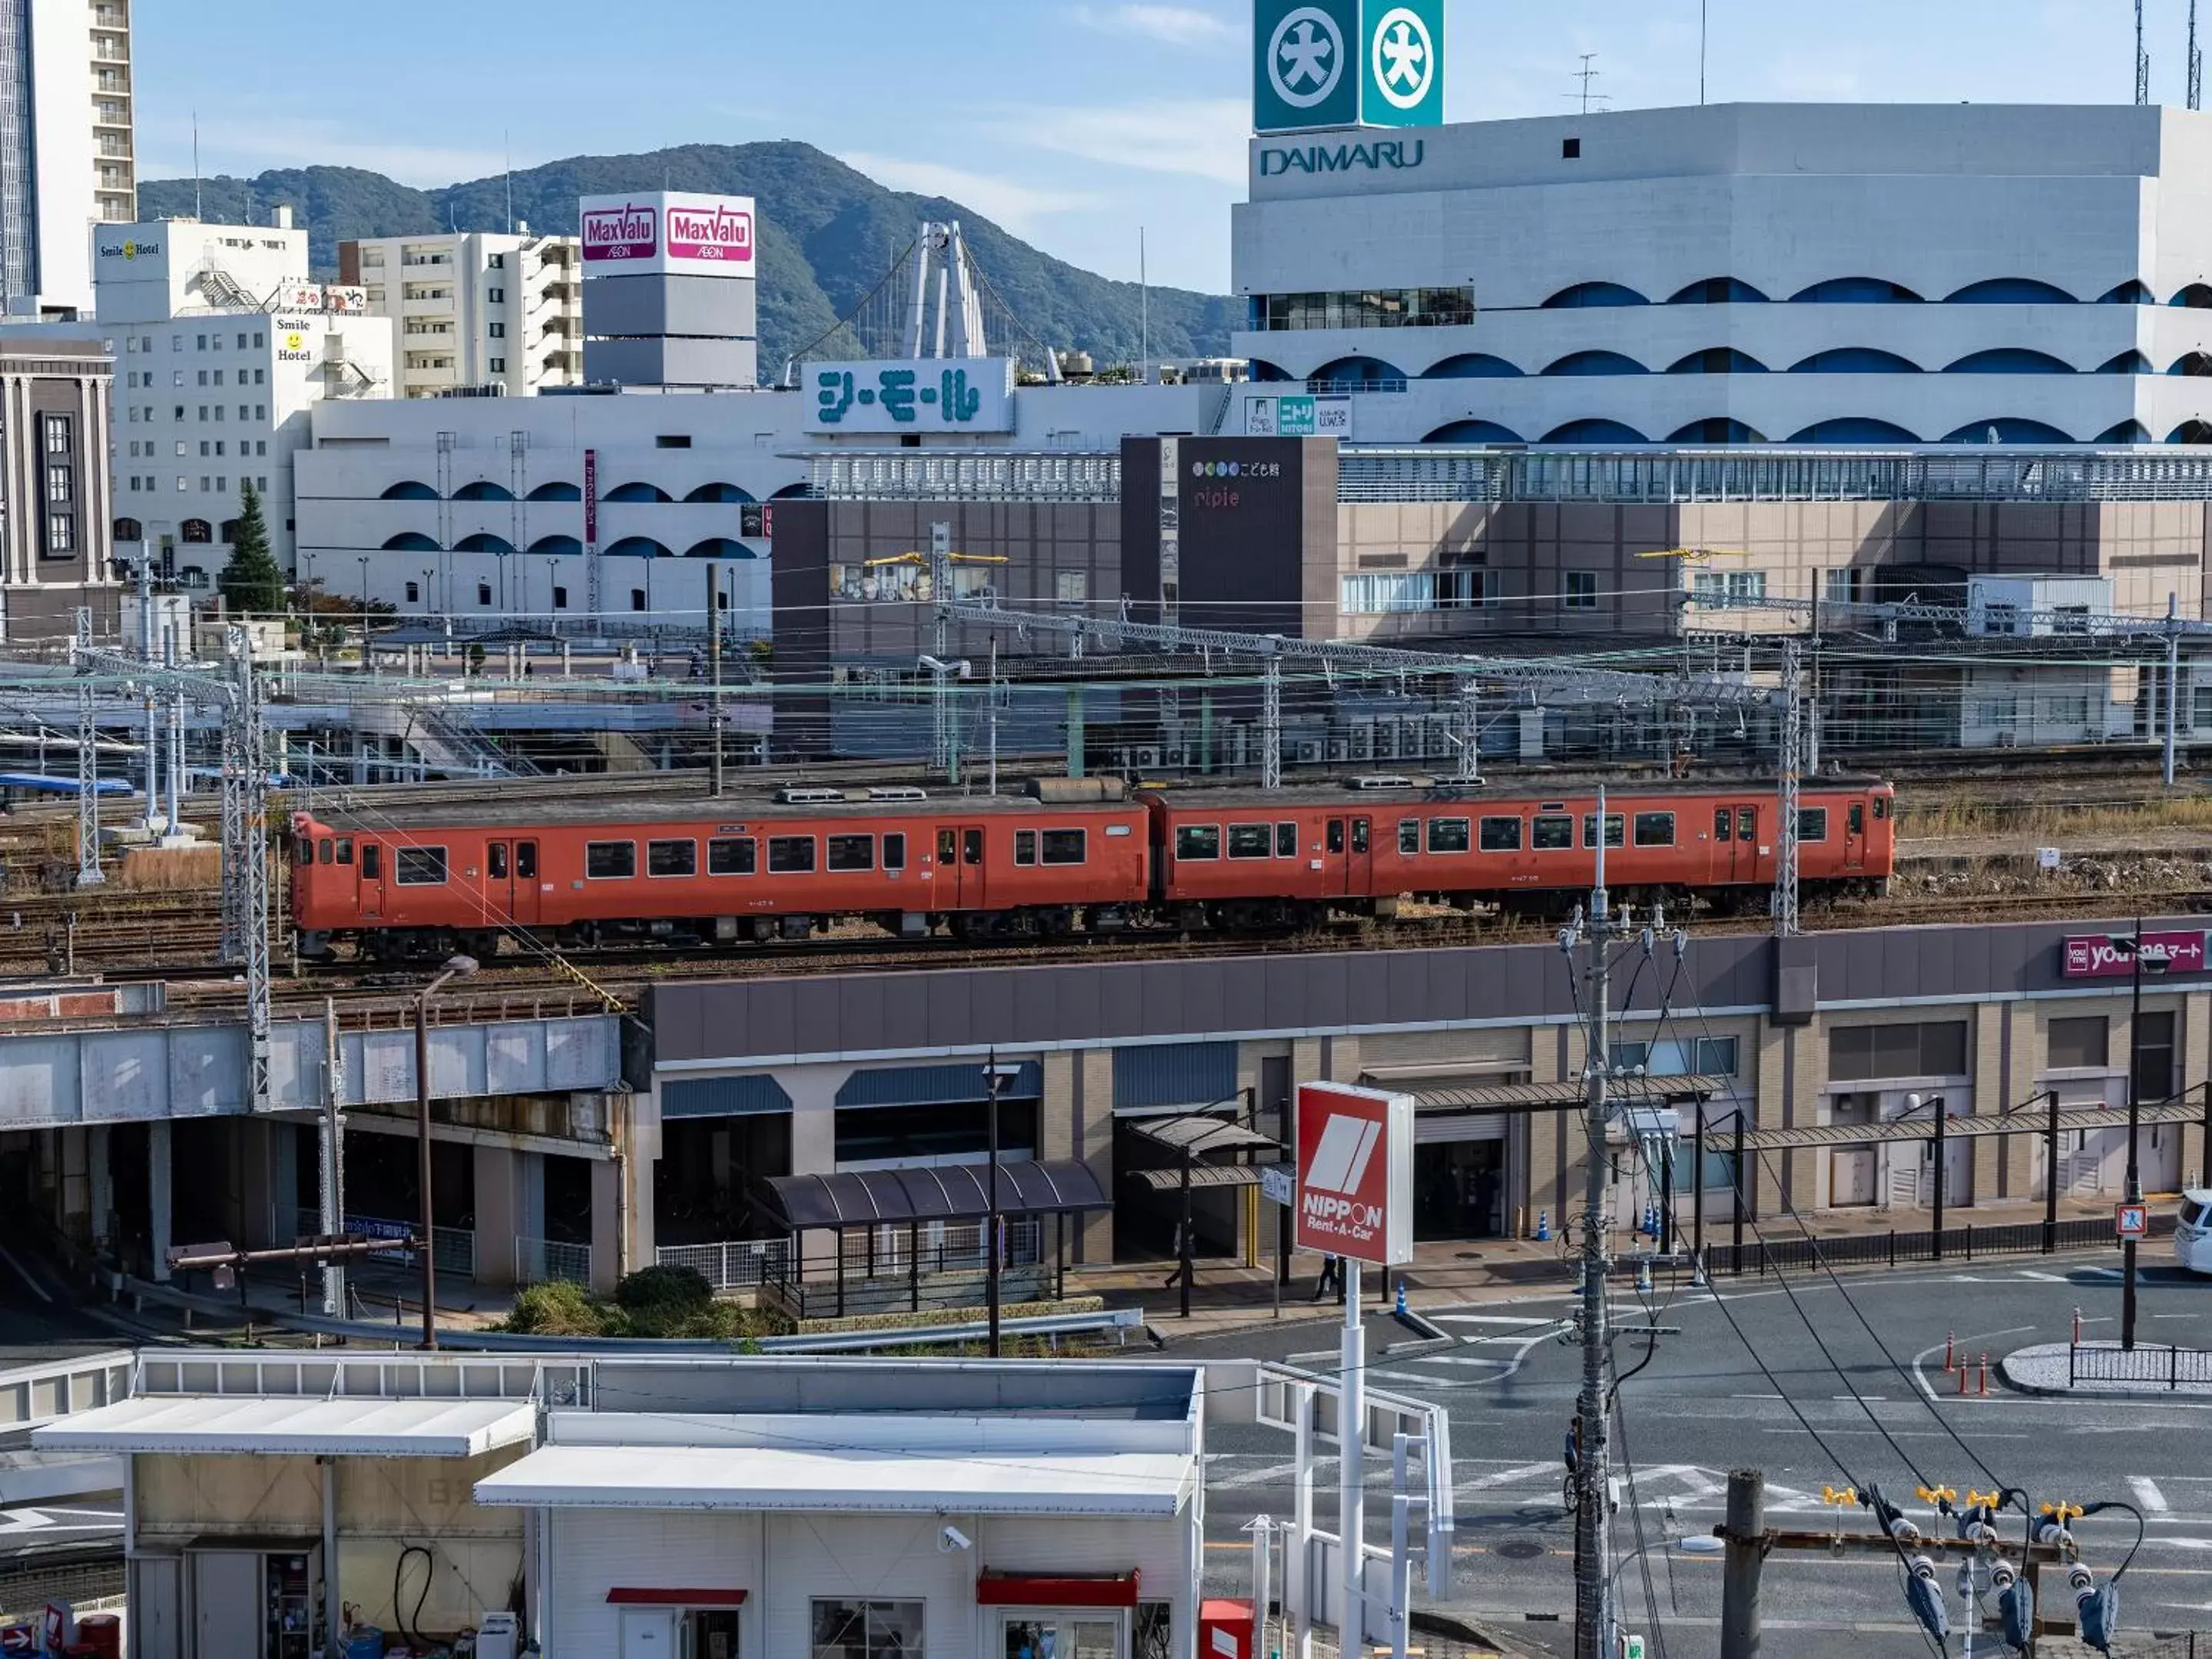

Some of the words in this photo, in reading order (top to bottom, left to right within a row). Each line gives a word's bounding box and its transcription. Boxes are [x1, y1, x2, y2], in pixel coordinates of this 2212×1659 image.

[1260, 140, 1424, 177] DAIMARU
[588, 203, 651, 243] MaxValu
[674, 204, 745, 243] MaxValu
[101, 246, 123, 257] Smile
[135, 243, 159, 255] Hotel
[277, 319, 310, 330] Smile
[278, 349, 310, 361] Hotel
[818, 369, 979, 422] シーモール
[1281, 405, 1313, 422] ニトリ
[1281, 423, 1313, 434] NITORI
[2070, 948, 2086, 958] you
[1303, 1192, 1382, 1229] NIPPON
